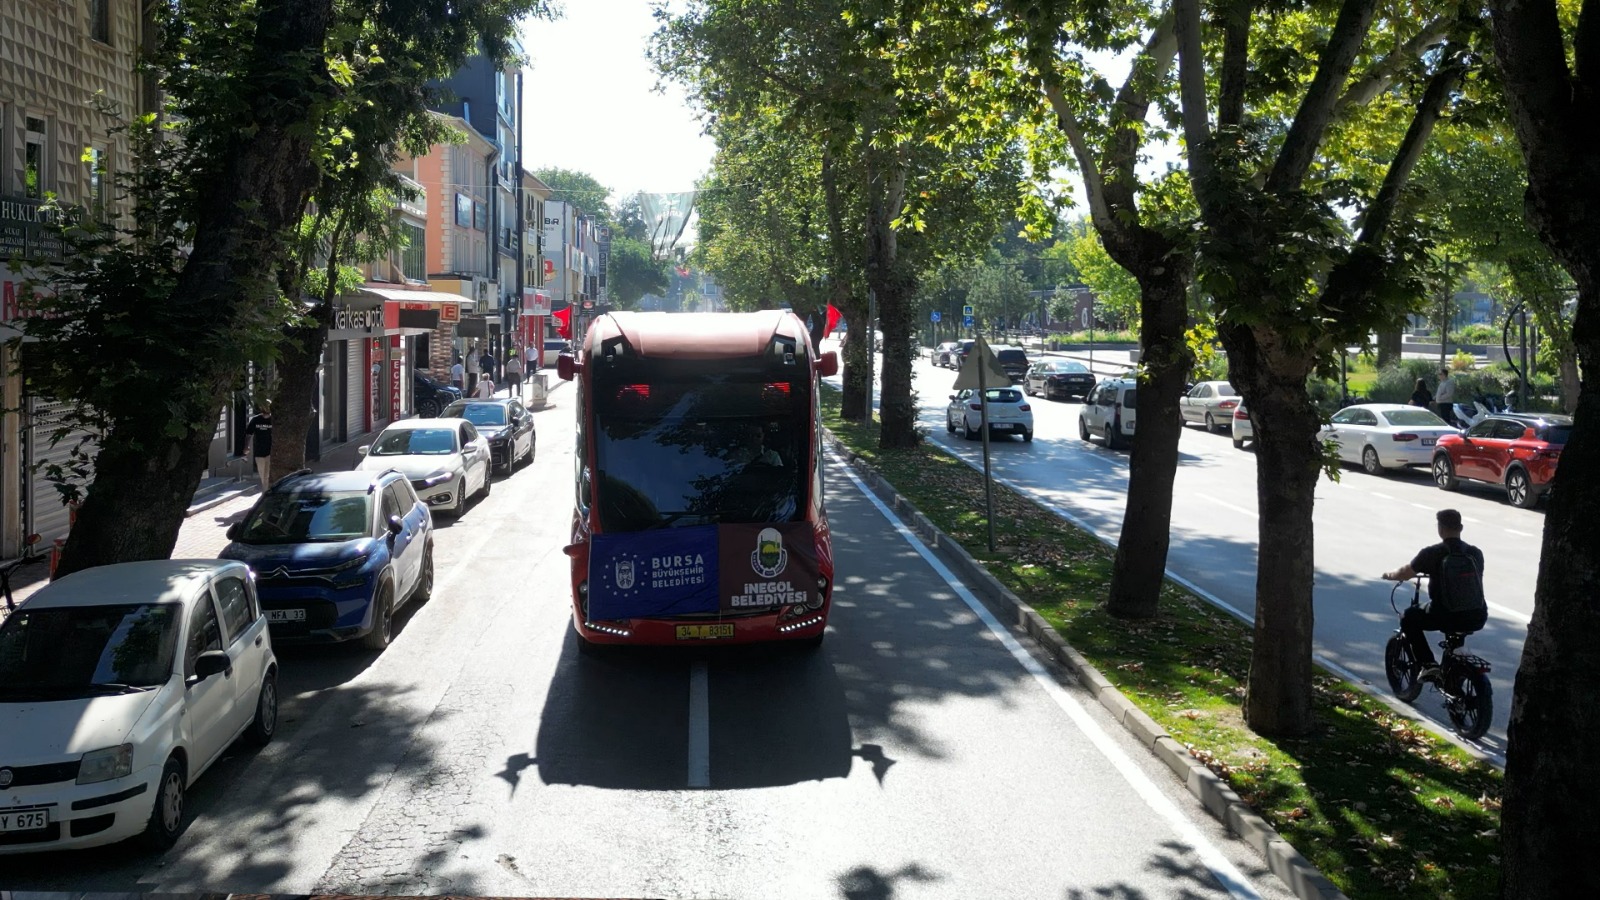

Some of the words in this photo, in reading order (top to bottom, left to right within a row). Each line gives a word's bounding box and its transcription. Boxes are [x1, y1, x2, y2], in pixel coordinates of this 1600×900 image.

[1, 201, 41, 223] HUKUK
[446, 306, 455, 318] E
[652, 553, 704, 569] BURSA
[652, 565, 704, 578] BÜYÜKŞEHİR
[652, 574, 705, 588] BELEDİYESİ
[271, 610, 288, 620] NFA
[294, 610, 304, 619] 33
[681, 626, 692, 637] 34
[696, 625, 702, 636] T
[17, 813, 43, 828] 675
